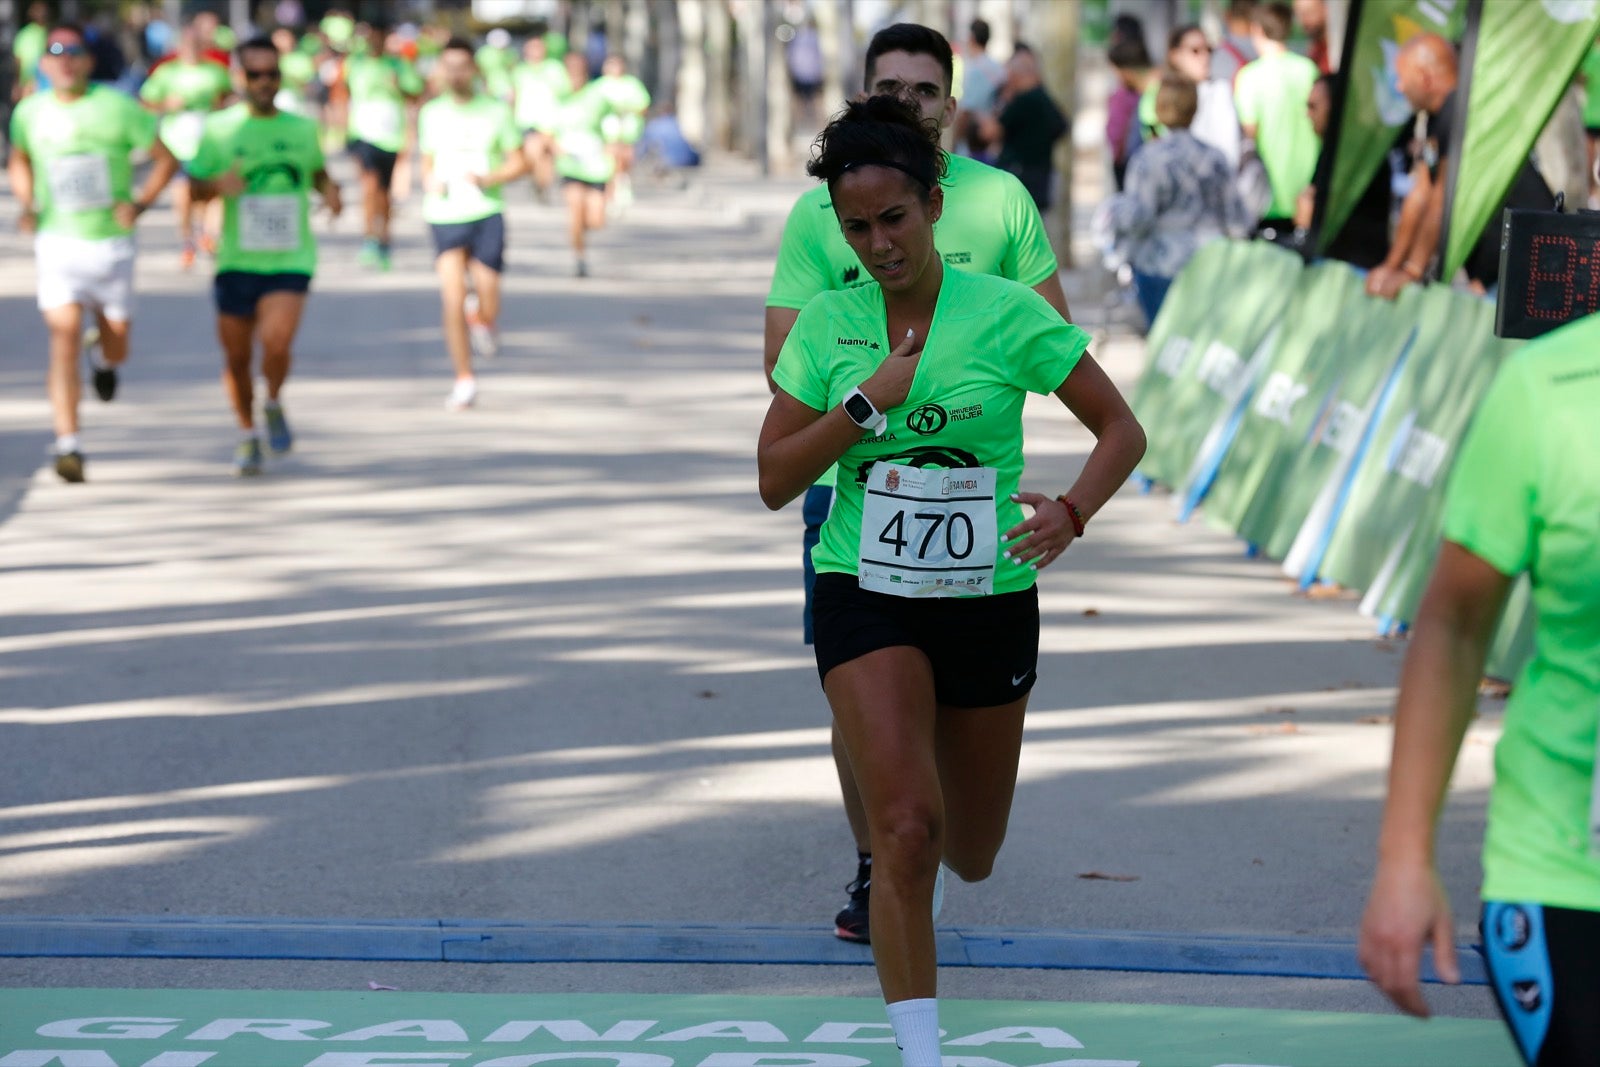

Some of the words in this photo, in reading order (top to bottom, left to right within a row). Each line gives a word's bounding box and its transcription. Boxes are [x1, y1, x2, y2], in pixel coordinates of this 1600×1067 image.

[837, 337, 868, 347] luanvi
[949, 404, 982, 415] UNIVERSO
[950, 410, 983, 422] MUJER
[878, 510, 974, 560] 470
[35, 1017, 1085, 1049] GRANADA
